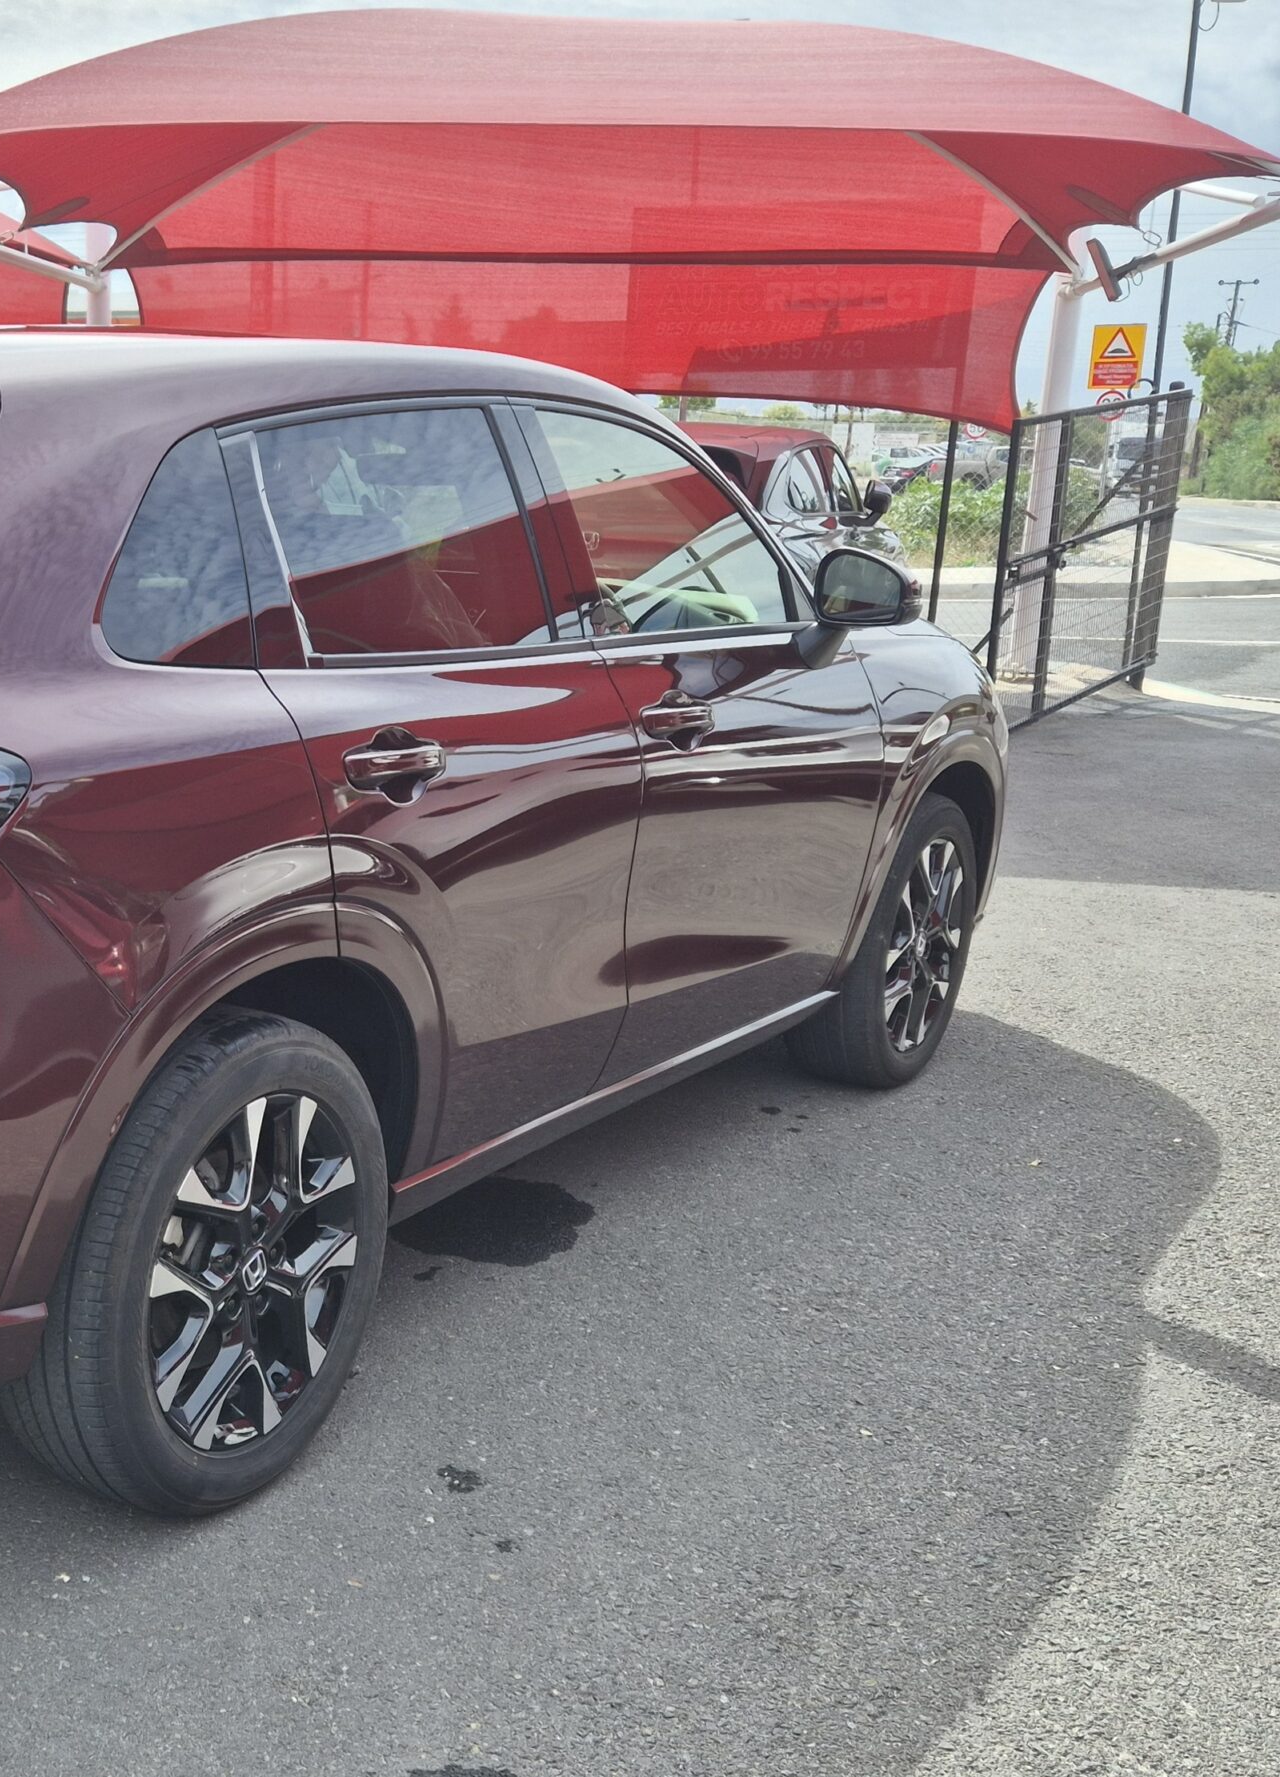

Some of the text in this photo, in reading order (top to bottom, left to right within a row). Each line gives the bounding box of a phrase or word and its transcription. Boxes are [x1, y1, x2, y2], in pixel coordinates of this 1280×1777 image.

[656, 320, 695, 336] BEST
[696, 320, 751, 335] DEALS
[749, 340, 865, 361] 99 55 79 43
